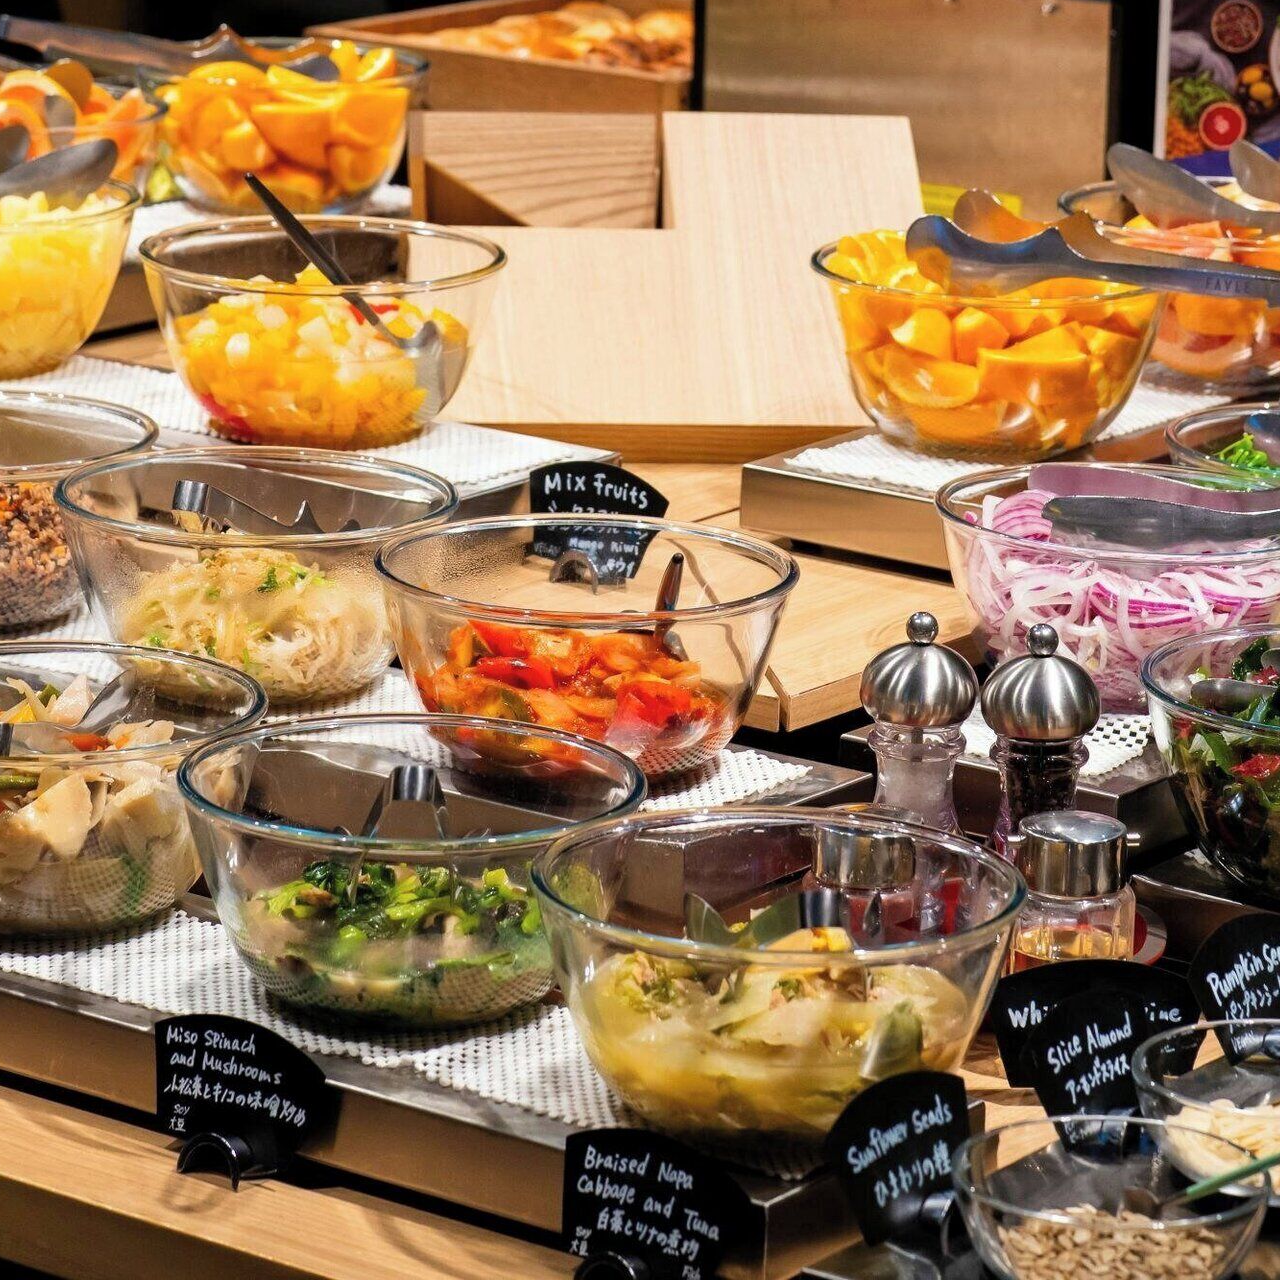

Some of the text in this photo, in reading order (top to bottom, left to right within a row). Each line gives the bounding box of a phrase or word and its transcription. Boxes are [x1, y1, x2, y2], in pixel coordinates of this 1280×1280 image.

[544, 472, 648, 509] Mix Fruits
[1206, 952, 1264, 1007] Pumpkin
[166, 1025, 197, 1044] Miso
[1047, 1035, 1082, 1074] Slice
[1085, 1011, 1132, 1054] Almond
[170, 1049, 282, 1085] and Mushrooms
[169, 1116, 186, 1131] 大豆
[847, 1094, 953, 1174] Sunflower Seeds
[584, 1144, 693, 1190] Braised Napa
[577, 1175, 719, 1240] Cabbage and Tuna
